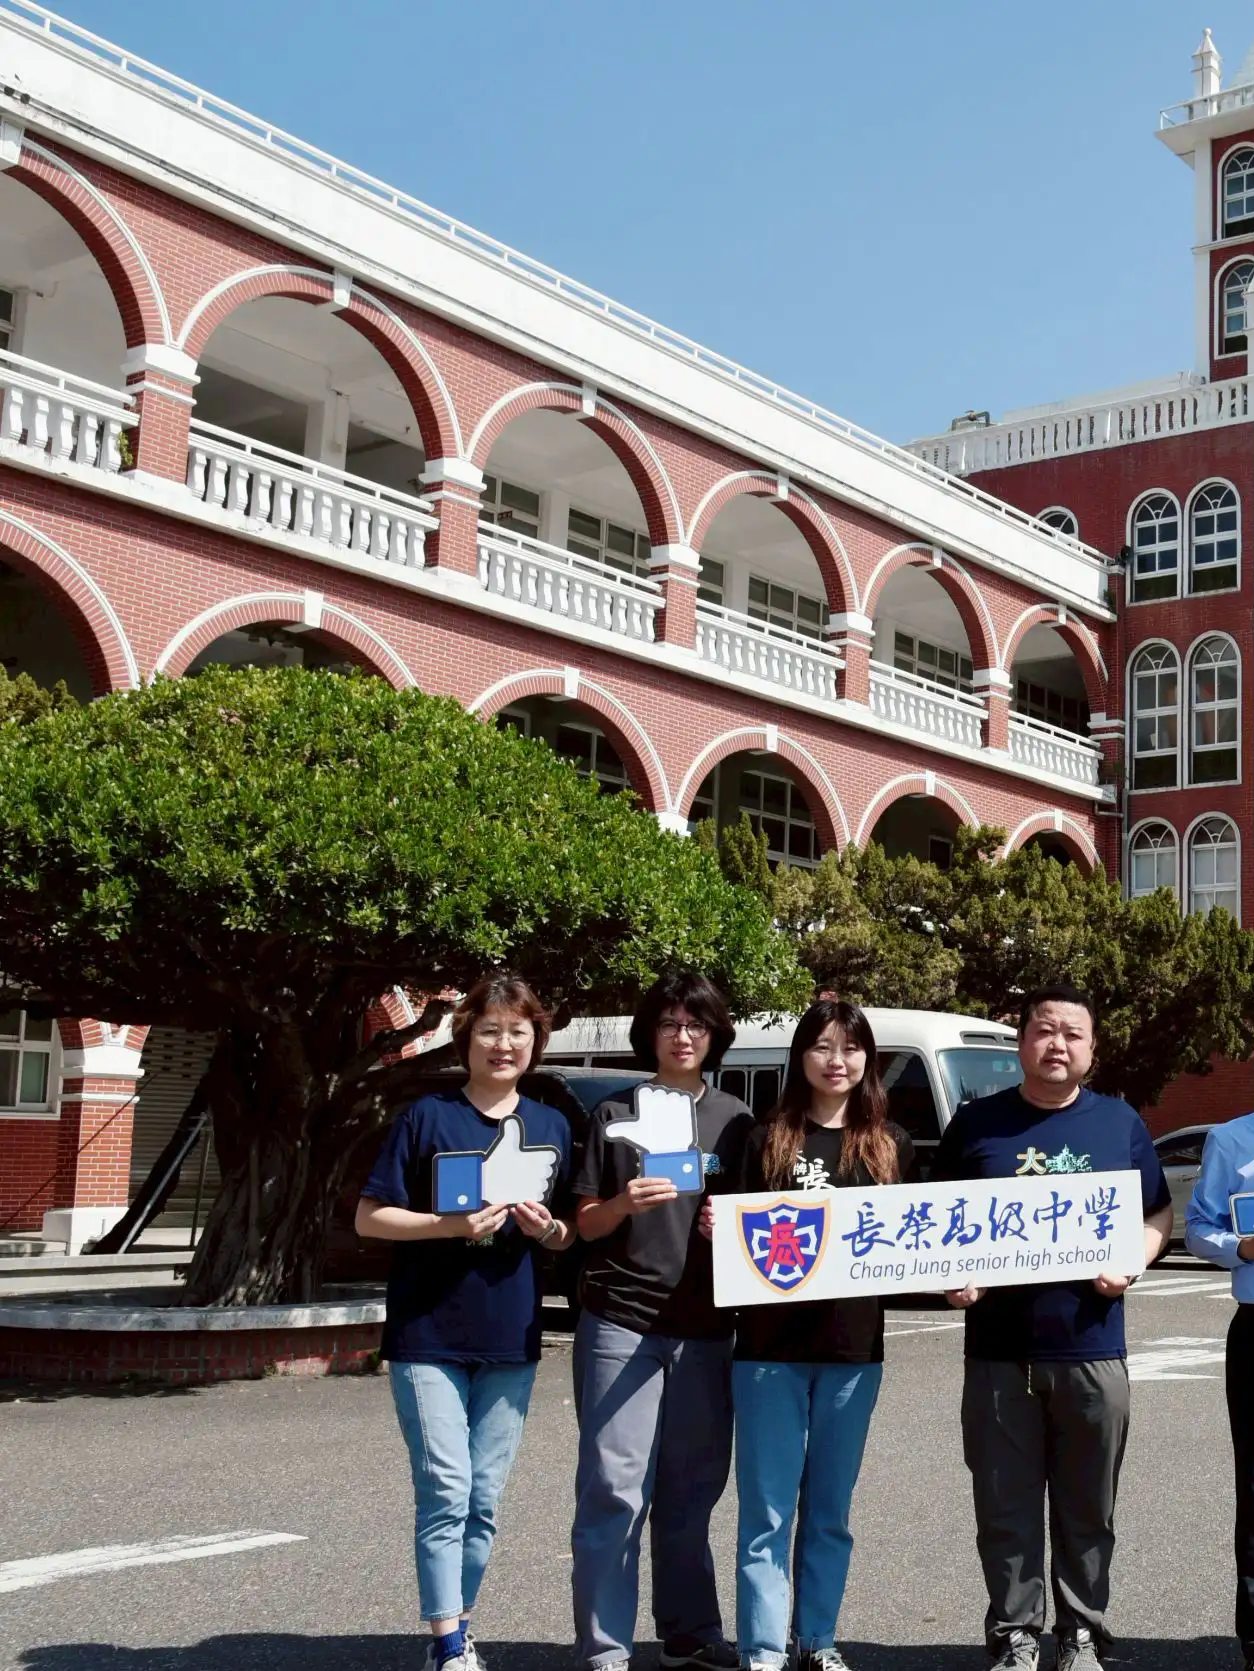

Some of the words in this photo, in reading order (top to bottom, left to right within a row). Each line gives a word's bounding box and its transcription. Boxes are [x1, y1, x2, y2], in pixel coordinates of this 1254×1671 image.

[842, 1186, 1120, 1257] 長榮高級中學
[849, 1260, 906, 1281] Chang
[909, 1258, 951, 1277] Jung
[957, 1252, 1010, 1273] senior
[1015, 1249, 1052, 1270] high
[1056, 1243, 1112, 1265] school
